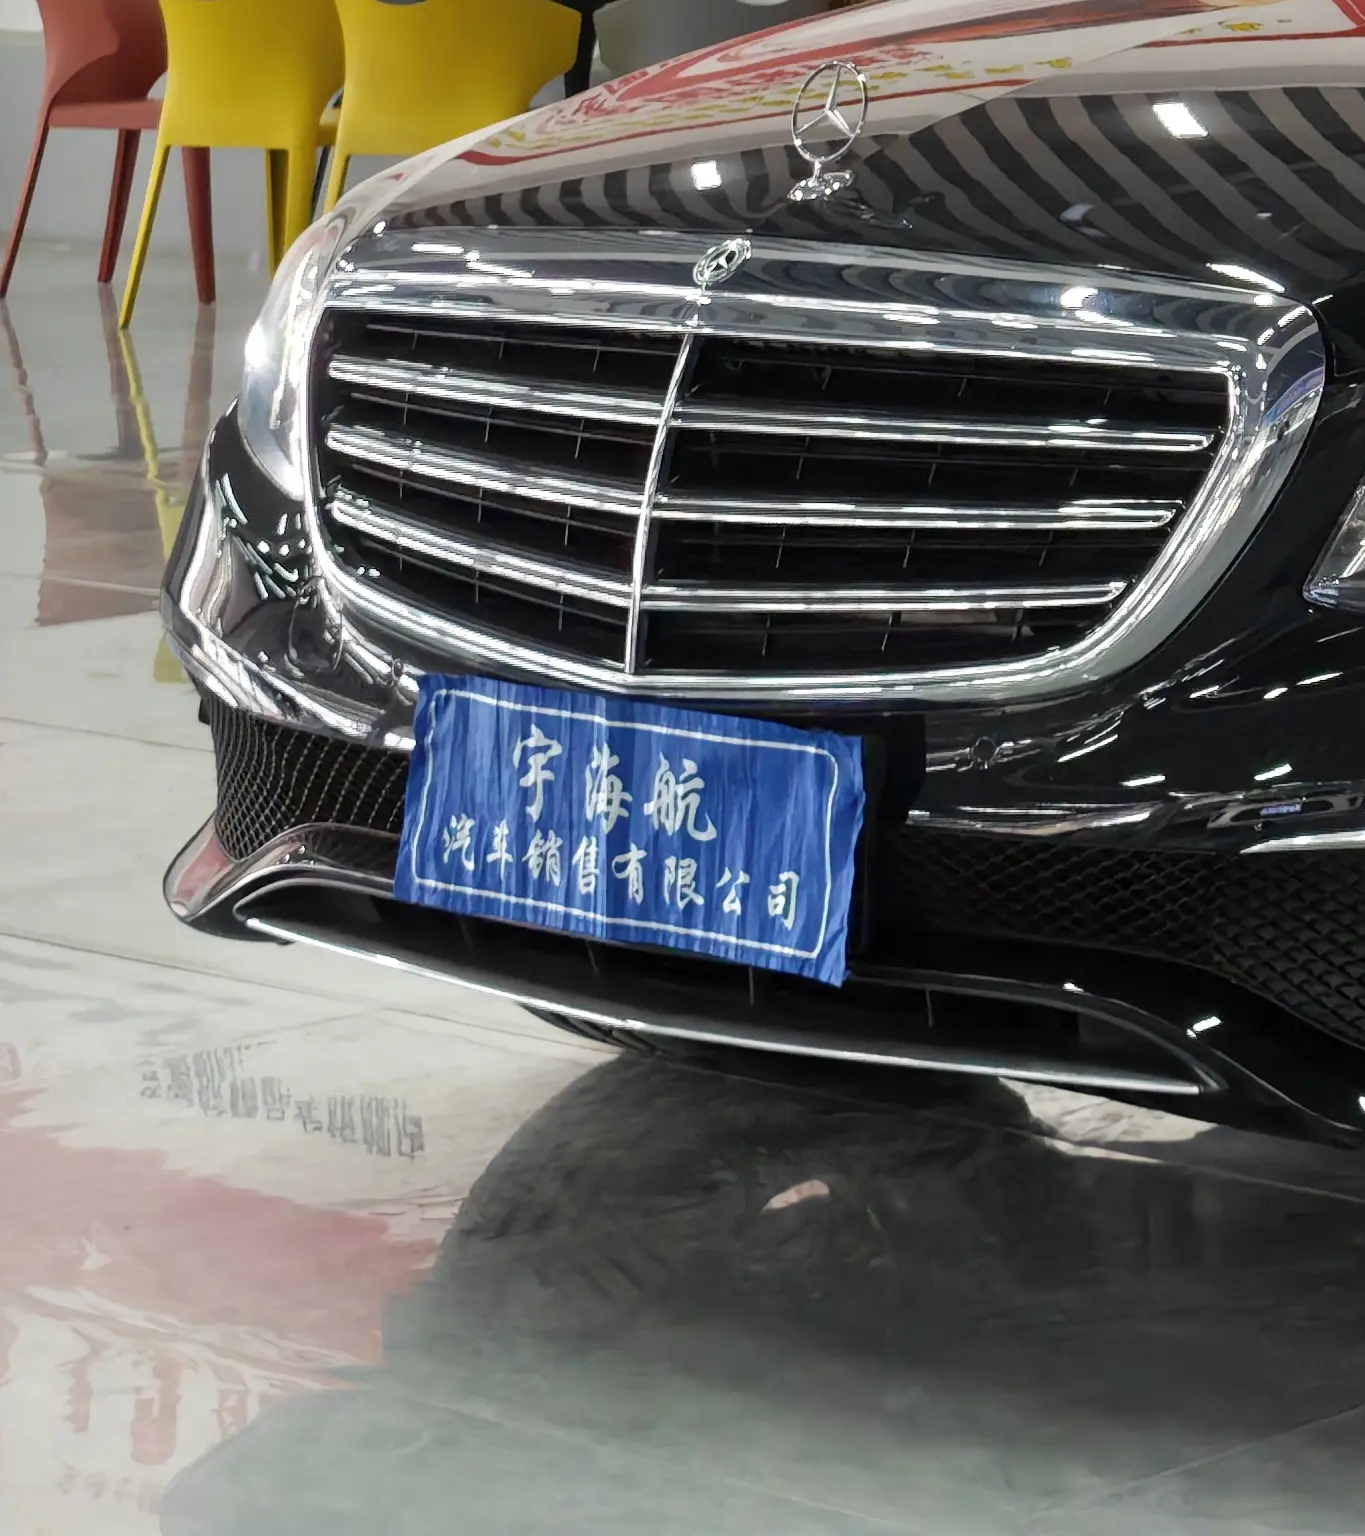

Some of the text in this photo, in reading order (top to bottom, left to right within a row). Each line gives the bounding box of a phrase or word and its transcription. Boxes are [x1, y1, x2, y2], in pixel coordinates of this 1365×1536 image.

[512, 723, 718, 843] 宇海航
[442, 814, 801, 932] 汽车销售有限公司
